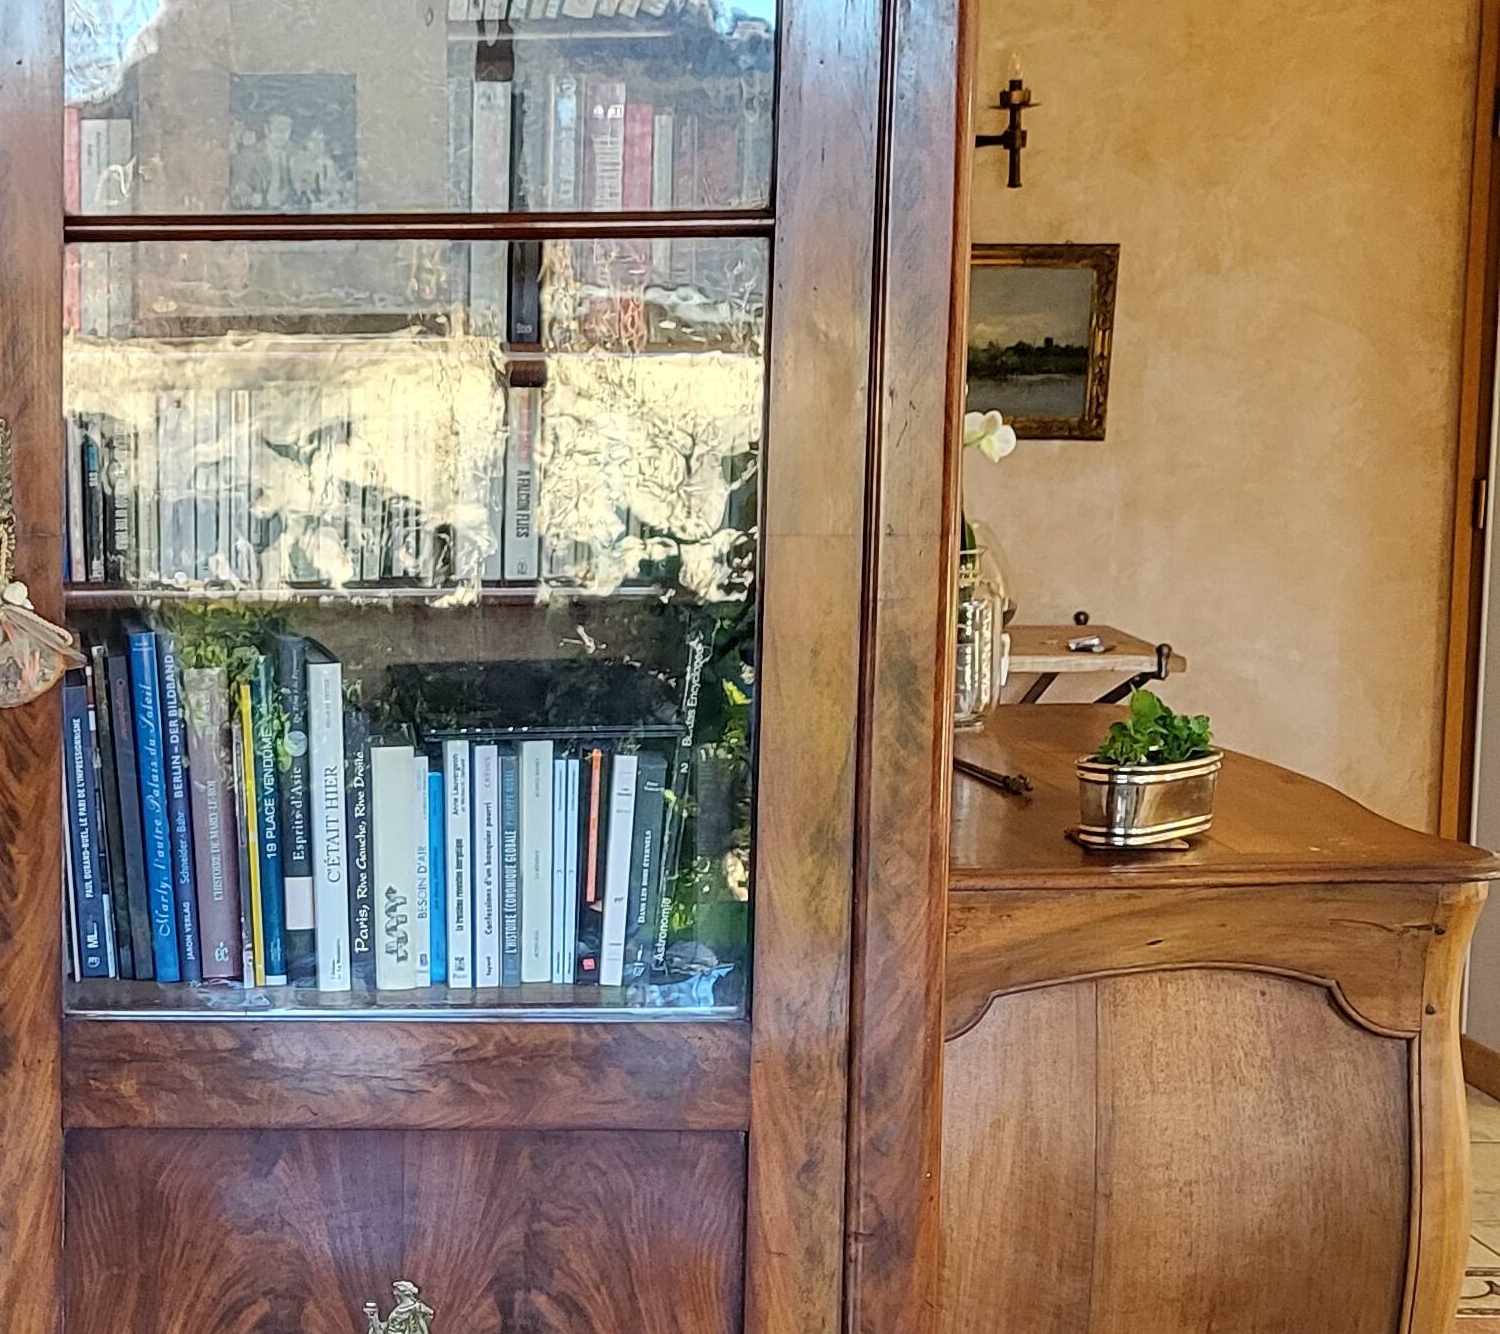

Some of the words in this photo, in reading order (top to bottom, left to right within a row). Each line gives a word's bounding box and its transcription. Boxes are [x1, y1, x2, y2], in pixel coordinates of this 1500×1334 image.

[516, 469, 533, 477] A
[515, 478, 533, 512] FALCON
[515, 513, 532, 538] FLIES
[164, 654, 179, 717] BILDBAND
[138, 683, 156, 734] Soleil
[143, 739, 156, 755] du
[167, 719, 180, 744] DER
[171, 755, 184, 799] BERLIN
[680, 762, 689, 773] 2
[145, 760, 162, 813] Palais
[290, 766, 304, 809] d'Asie
[322, 765, 340, 810] HIER
[78, 798, 88, 816] PARI
[263, 797, 276, 839] PLACE
[354, 791, 367, 818] Rive
[451, 794, 461, 816] Anne
[483, 802, 494, 827] pourri
[209, 840, 221, 854] DE
[264, 842, 278, 860] 19
[292, 810, 308, 861] Esprits
[323, 812, 341, 884] C'ÉTAIT
[355, 820, 368, 870] Gauche,
[483, 829, 494, 866] banquier
[503, 830, 517, 862] GLOBALE
[416, 845, 428, 874] D'AIR
[83, 880, 95, 898] PAUL
[209, 855, 224, 902] L'HISTOIRE
[356, 872, 368, 899] Rive
[483, 867, 493, 886] d'un
[502, 864, 518, 912] ÉCONOMIQUE
[417, 876, 428, 920] BESOIN
[483, 888, 493, 935] Confessions
[637, 902, 647, 923] DANS
[181, 901, 193, 933] VERLAG
[353, 904, 371, 953] Paris,
[184, 934, 196, 961] JARON
[504, 914, 518, 954] L'HISTOIRE
